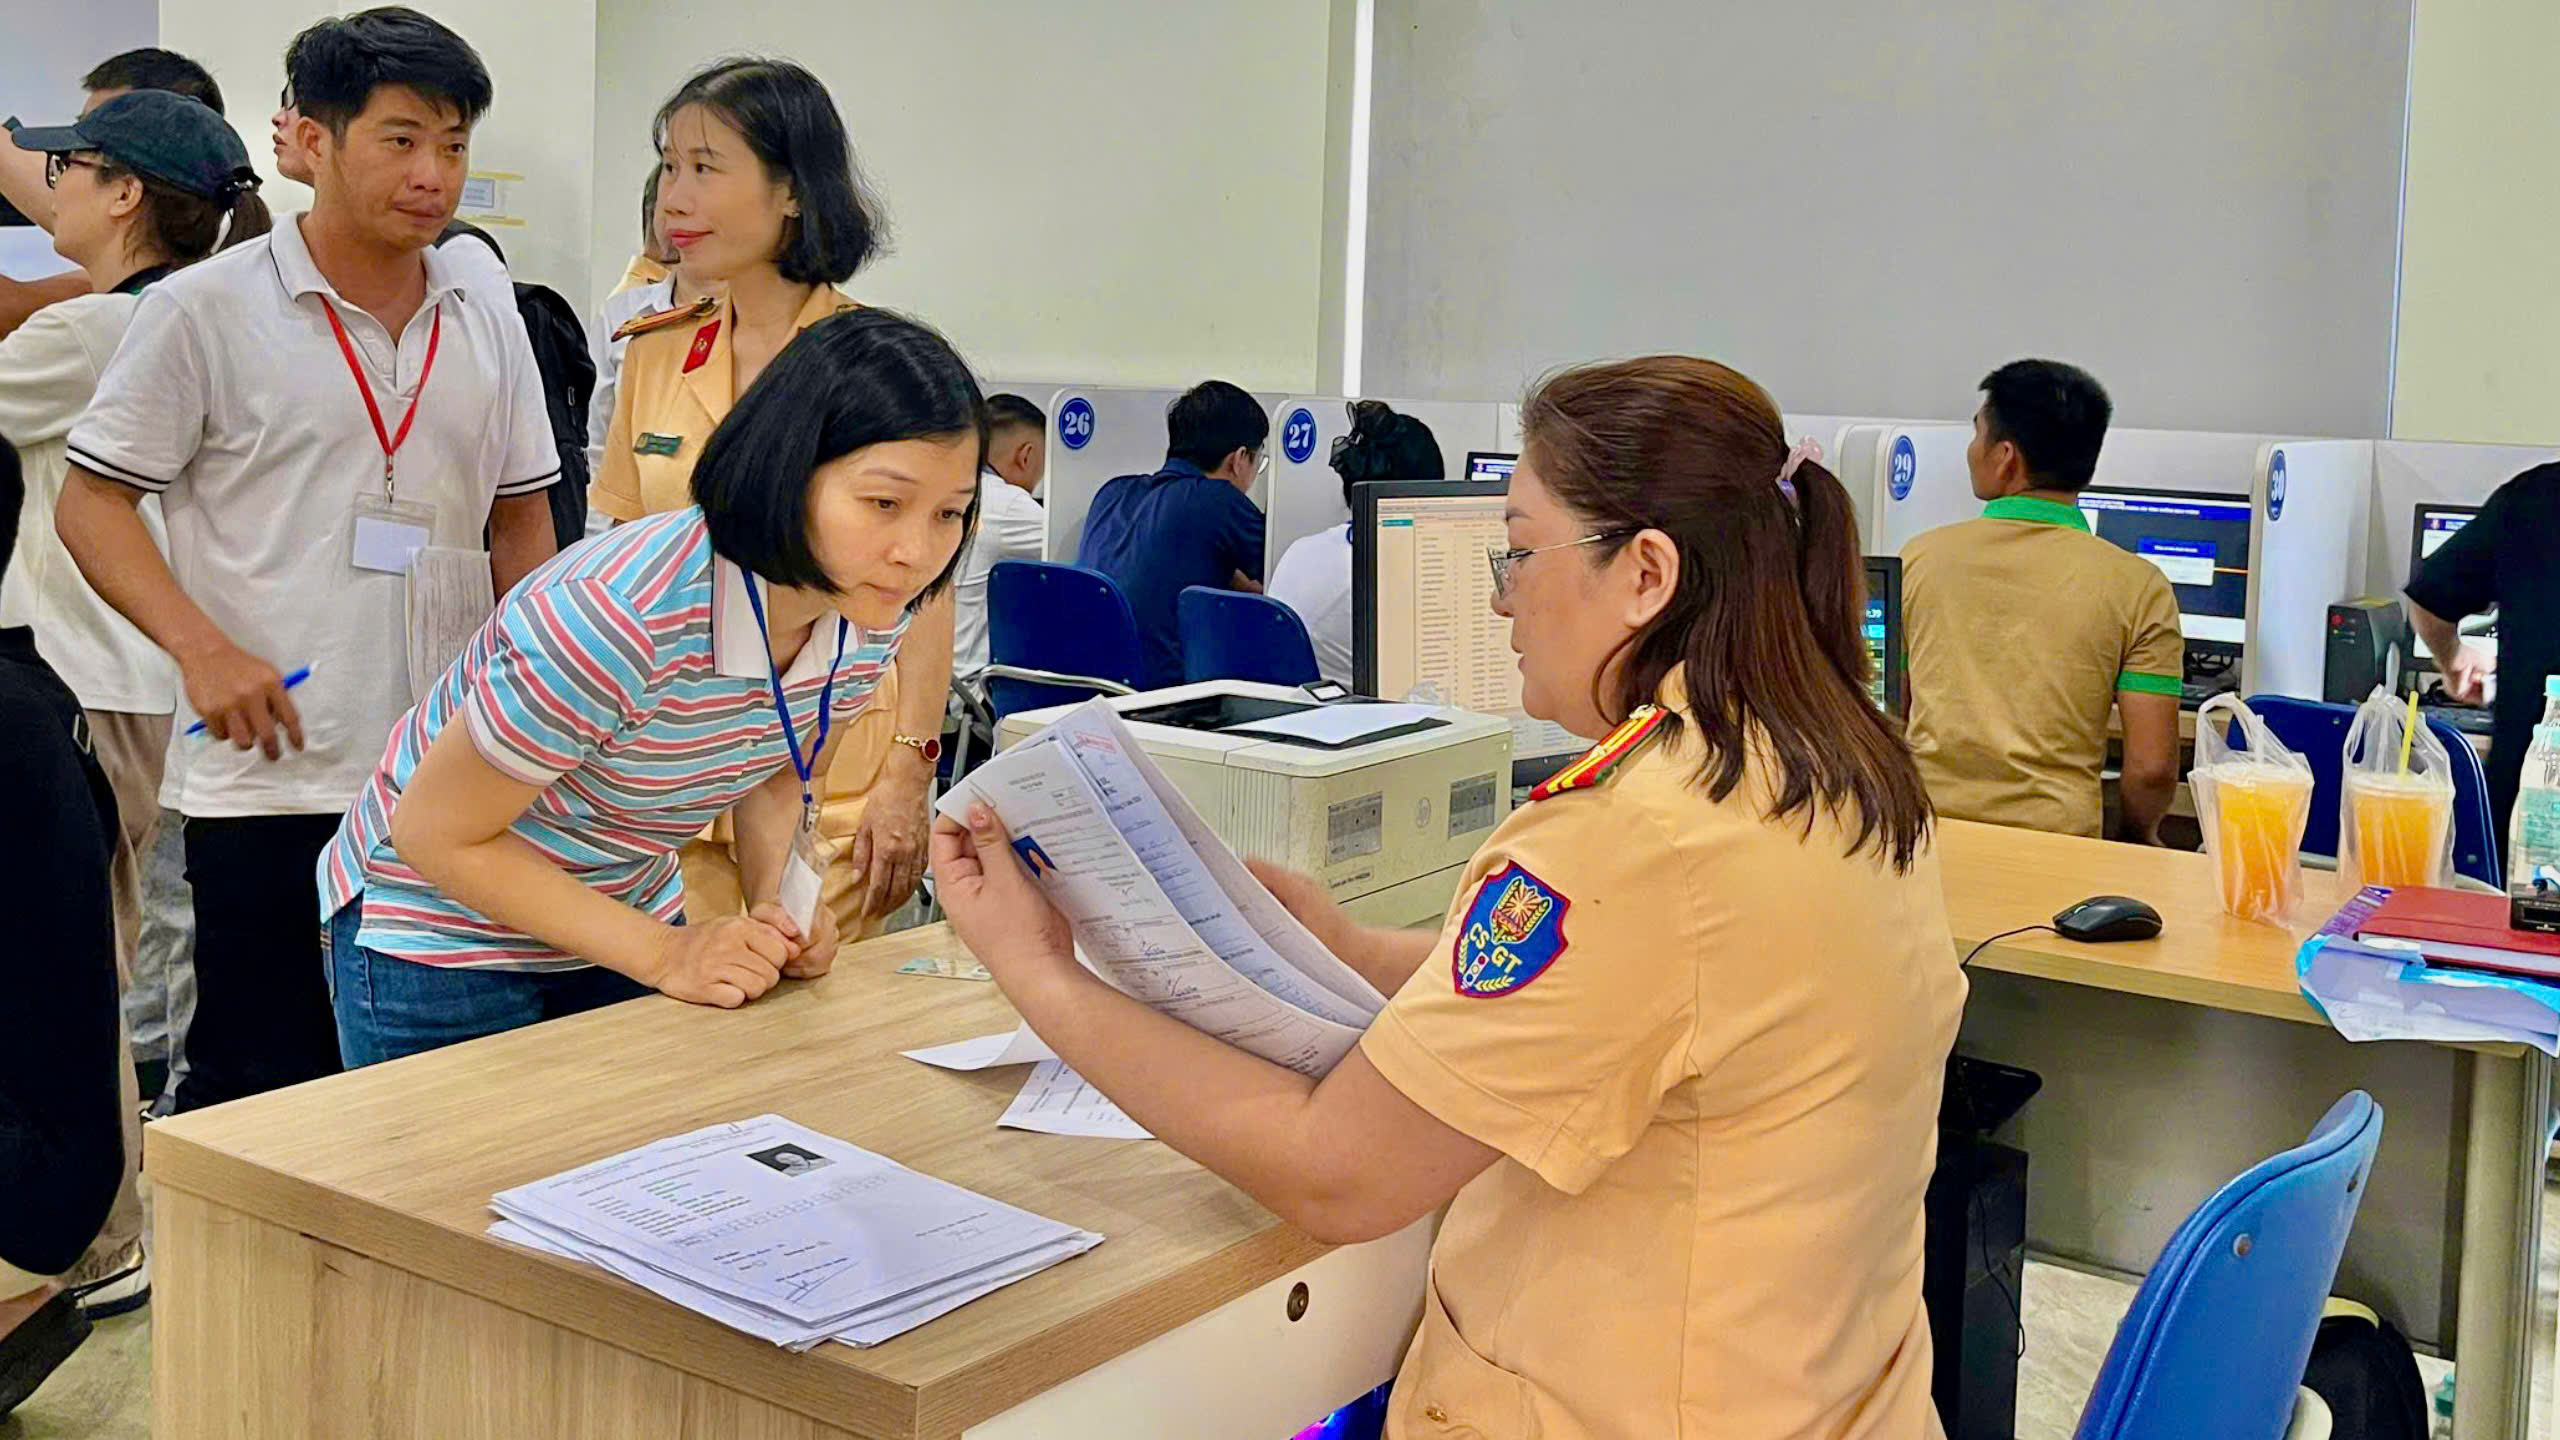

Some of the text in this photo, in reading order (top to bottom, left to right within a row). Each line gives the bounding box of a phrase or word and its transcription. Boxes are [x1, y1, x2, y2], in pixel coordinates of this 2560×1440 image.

[1064, 411, 1090, 436] 26
[1288, 422, 1311, 448] 27
[1894, 453, 1912, 482] 29
[2271, 470, 2285, 501] 30
